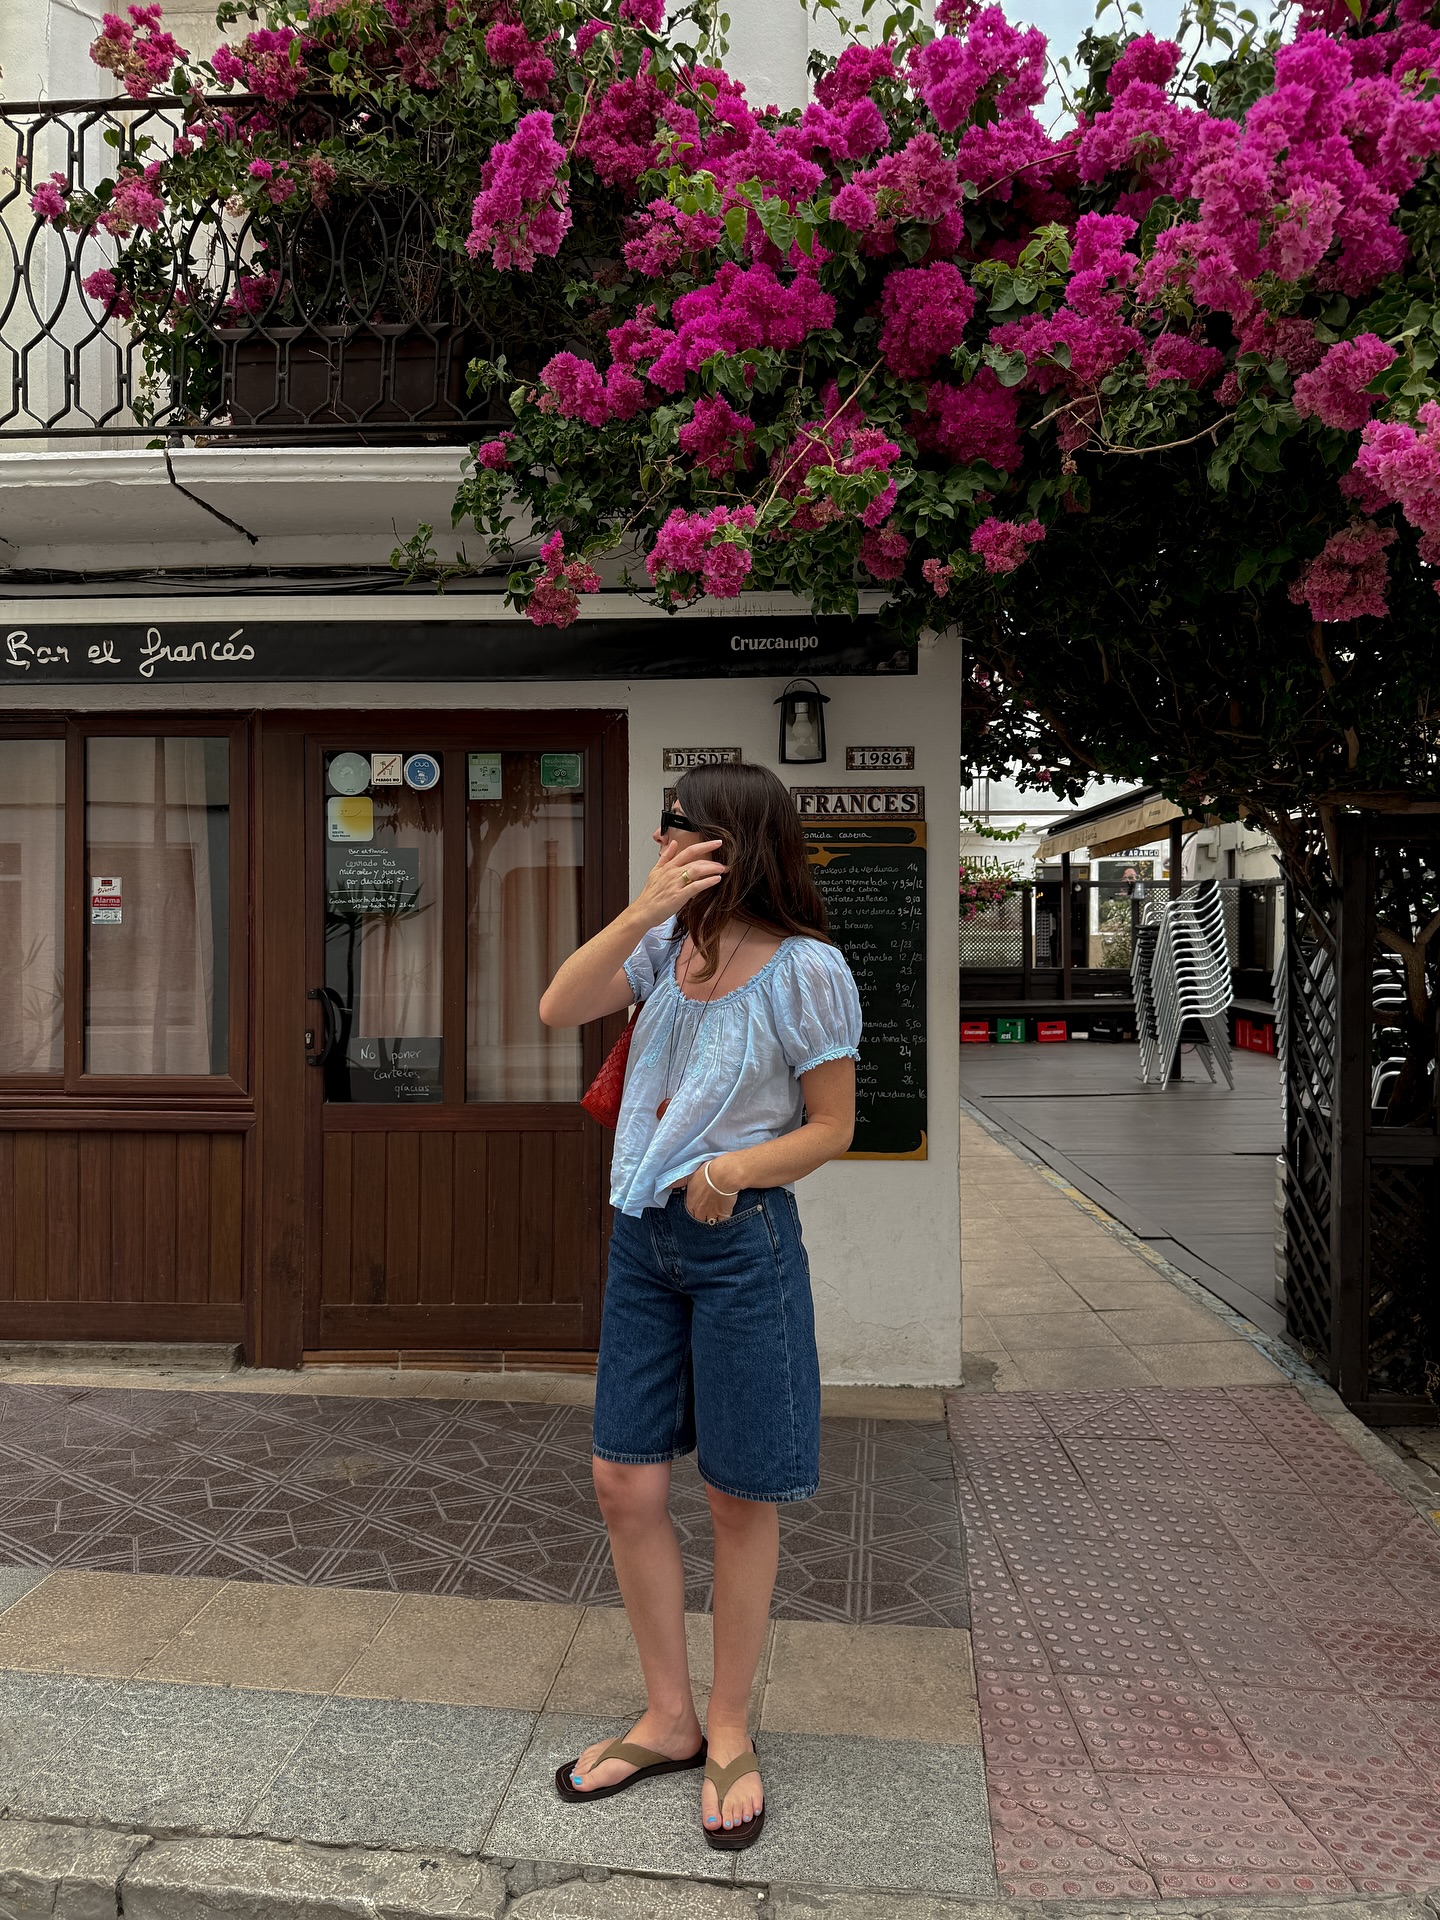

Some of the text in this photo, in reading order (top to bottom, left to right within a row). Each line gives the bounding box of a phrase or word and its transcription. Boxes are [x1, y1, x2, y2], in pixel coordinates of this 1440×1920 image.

[730, 635, 819, 652] Cruzcampo
[6, 627, 255, 677] Bar el francés
[673, 753, 730, 766] DESDE
[859, 752, 904, 765] 1986
[798, 794, 917, 814] FRANCES
[801, 830, 873, 839] omida casera
[1128, 849, 1159, 857] ARANGO
[382, 858, 396, 867] los
[848, 866, 860, 874] de
[860, 865, 900, 873] verduras
[907, 863, 919, 873] 14
[373, 869, 380, 879] y
[381, 867, 406, 878] jueves
[346, 879, 358, 889] por
[845, 877, 889, 887] mermelada
[822, 886, 844, 894] queso
[904, 895, 921, 905] 9,50
[842, 907, 854, 915] de
[855, 907, 896, 916] verduras
[844, 919, 875, 930] bravas
[844, 940, 877, 953] plancha
[863, 952, 893, 965] plancha
[905, 1018, 922, 1030] 5,50
[360, 1044, 422, 1065] No poner
[899, 1045, 912, 1058] 24
[856, 1076, 878, 1084] vaca
[394, 1083, 430, 1099] gracias
[869, 1091, 876, 1105] y
